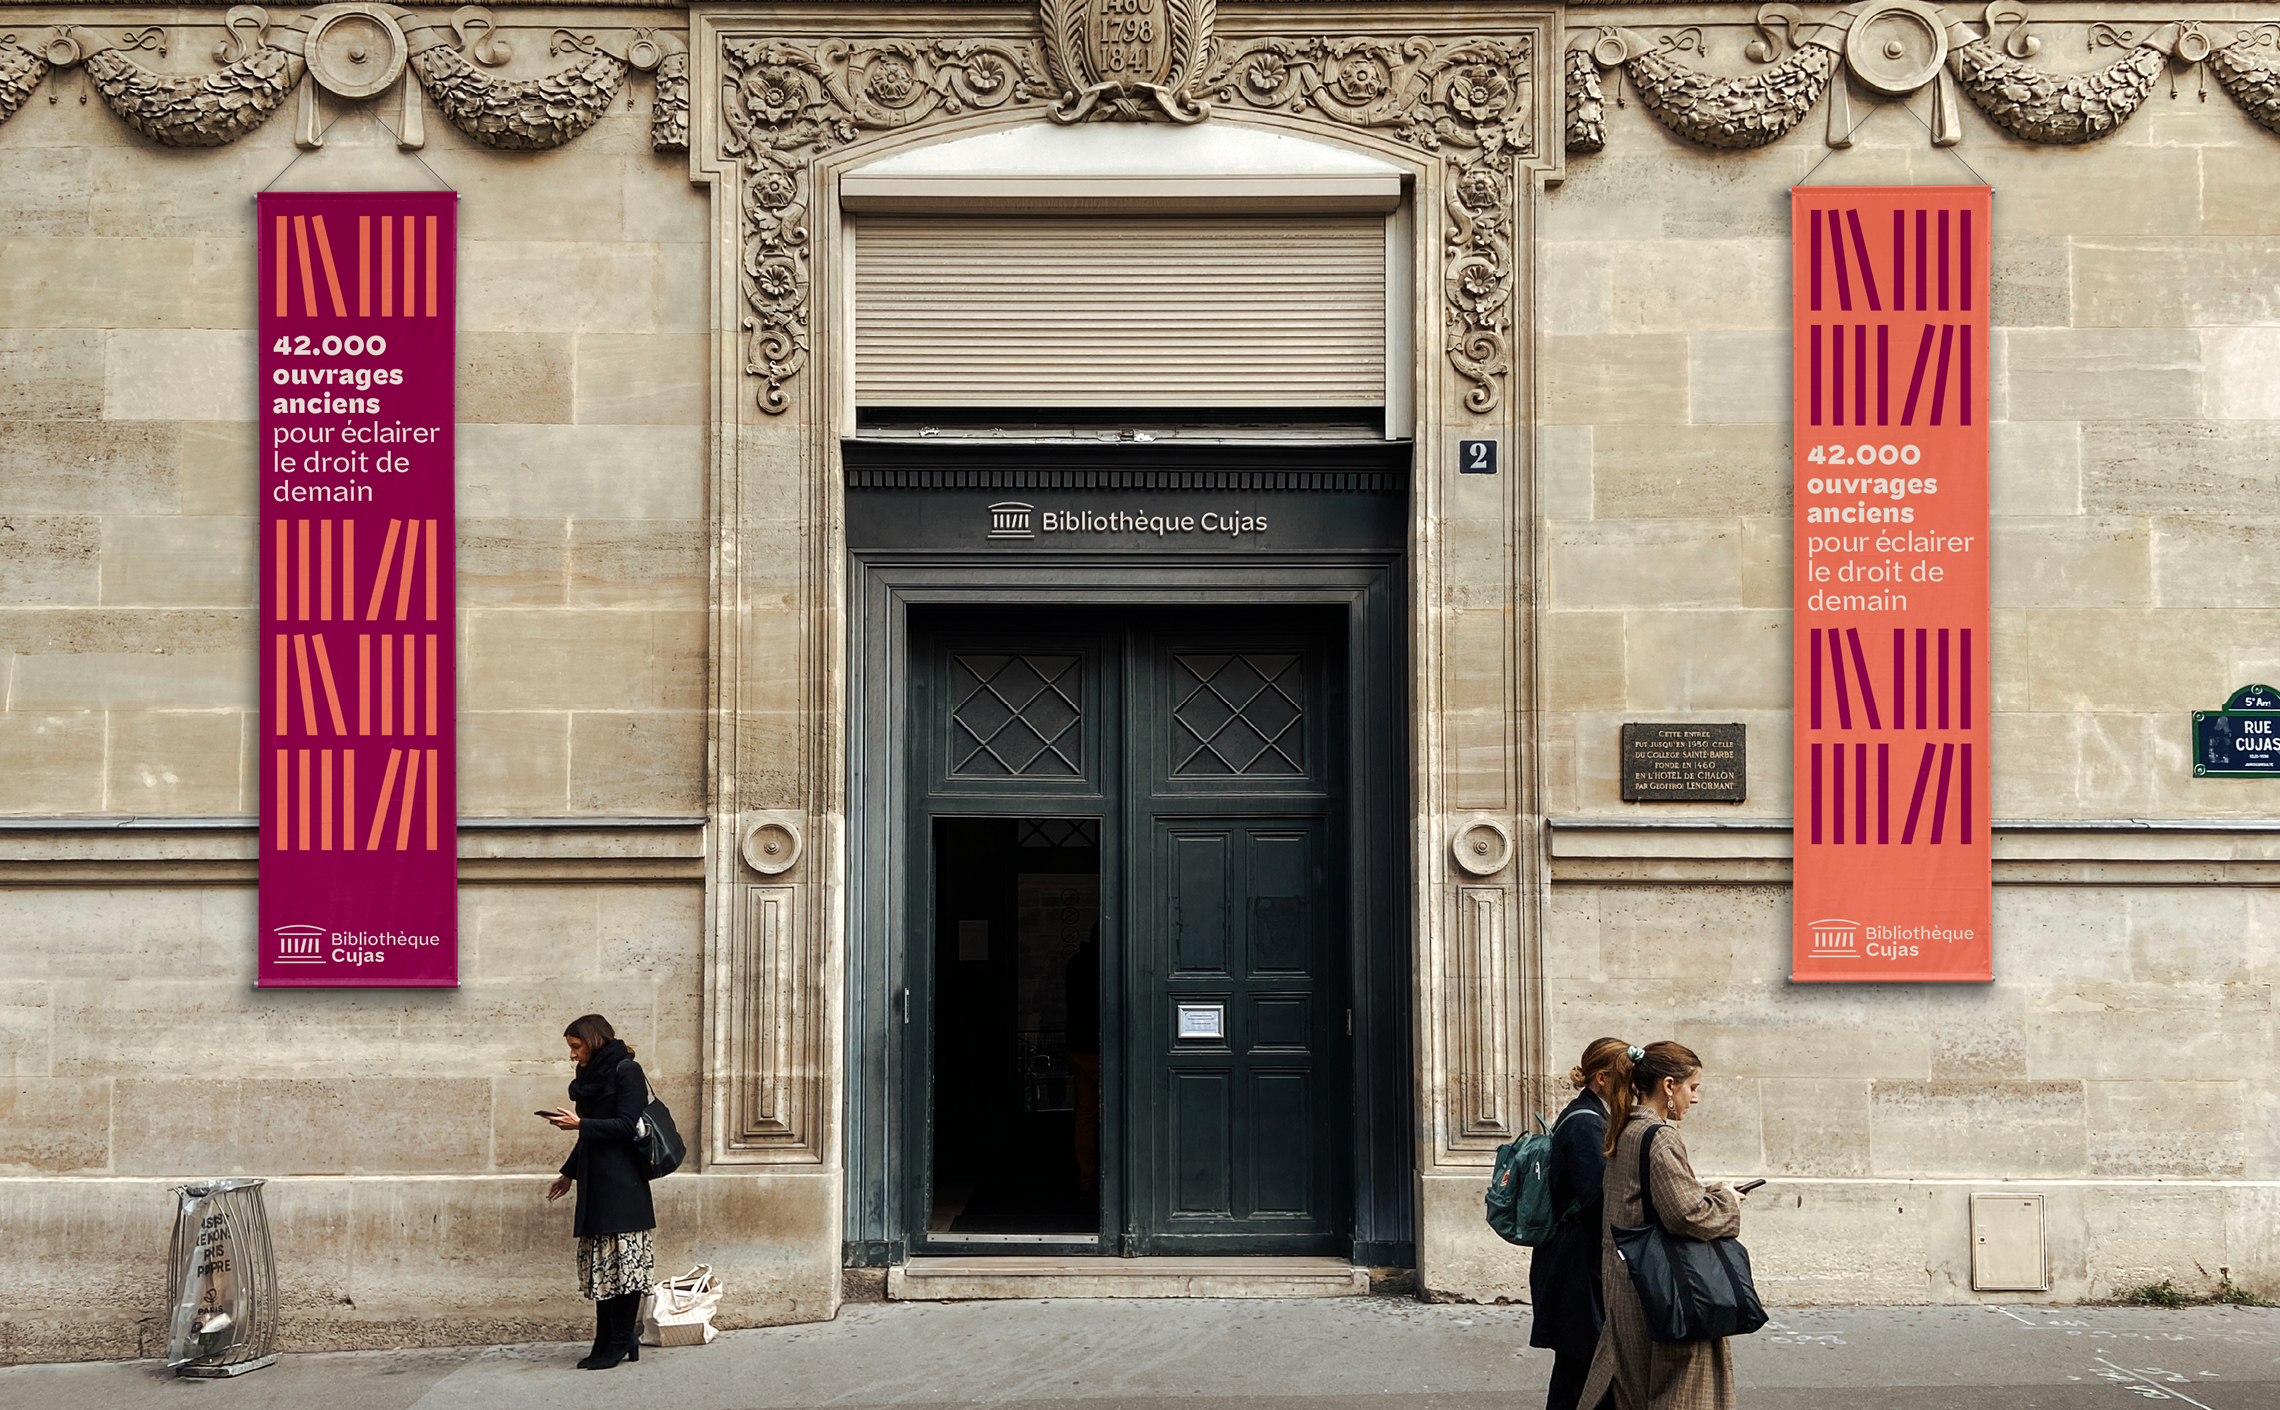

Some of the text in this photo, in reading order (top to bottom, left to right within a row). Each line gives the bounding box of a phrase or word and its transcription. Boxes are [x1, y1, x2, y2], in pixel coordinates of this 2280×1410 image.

[1101, 19, 1153, 42] 1798
[1101, 47, 1153, 72] 1841
[274, 336, 386, 356] 42.000
[273, 369, 404, 391] ouvrages
[273, 391, 380, 414] anciens
[274, 420, 440, 448] pour éclairer
[274, 450, 410, 472] le droit de
[1469, 443, 1487, 469] 2
[1808, 444, 1921, 465] 42.000
[273, 479, 372, 502] demain
[1807, 478, 1938, 500] ouvrages
[1043, 509, 1268, 537] Bibliothèque Cujas
[1807, 501, 1914, 523] anciens
[1808, 529, 1975, 557] pour éclairer
[1808, 560, 1944, 582] le droit de
[1807, 588, 1907, 611] demain
[2244, 720, 2272, 734] RUE
[2235, 737, 2280, 751] CUJAS
[1635, 772, 1646, 780] EN
[1697, 771, 1735, 780] CHALON
[1694, 761, 1716, 769] 1460
[1686, 782, 1734, 790] LENORMANT
[332, 931, 440, 950] Bibliothèque
[1866, 925, 1974, 944] Bibliothèque
[331, 947, 385, 966] Cujas
[1866, 941, 1919, 961] Cujas
